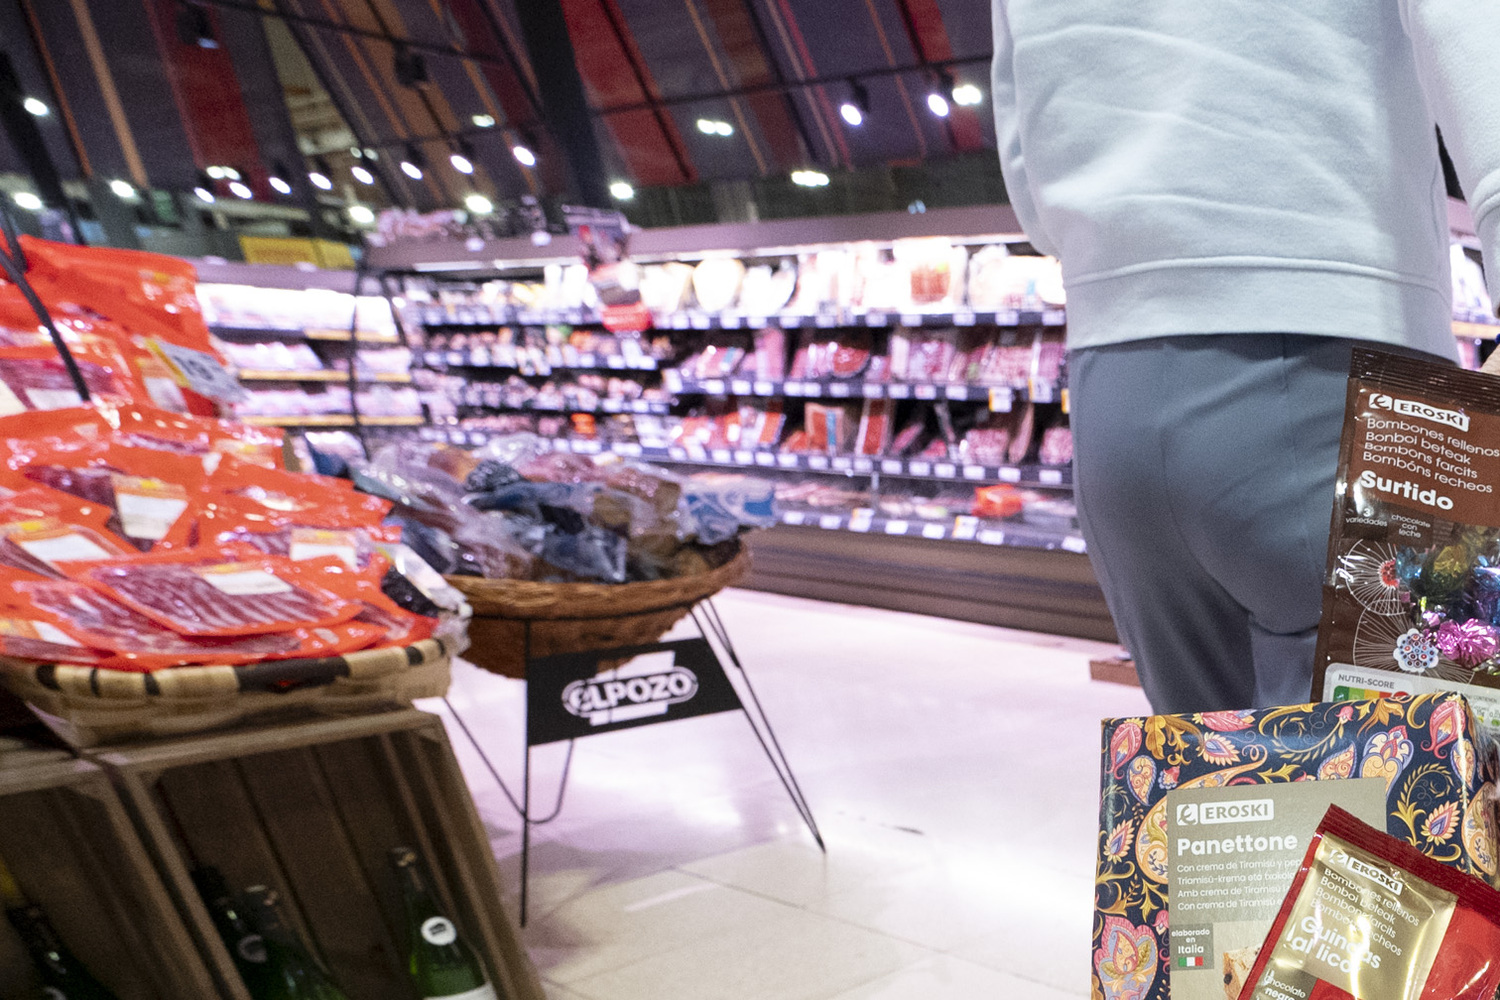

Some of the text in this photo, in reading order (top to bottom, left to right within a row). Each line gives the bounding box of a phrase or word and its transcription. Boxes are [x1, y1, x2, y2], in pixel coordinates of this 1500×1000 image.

[1400, 403, 1464, 427] EROSKI
[1367, 418, 1500, 457] Bombones rellenos
[1366, 432, 1471, 465] Bonboi beteak
[1365, 442, 1477, 479] Bombons farcits
[1363, 451, 1493, 493] Bombóns recheos
[1361, 470, 1454, 510] Surtido
[1363, 507, 1371, 517] 3
[1346, 517, 1388, 527] variedades
[1391, 514, 1431, 528] chocolate
[1402, 523, 1418, 531] con
[1399, 529, 1421, 538] leche
[1337, 673, 1396, 690] NUTRI-SCORE
[1205, 804, 1268, 820] EROSKI
[1177, 834, 1298, 856] Panettone
[1177, 864, 1195, 873] Con
[1196, 864, 1223, 872] crema
[1225, 862, 1237, 870] de
[1277, 861, 1283, 869] y
[1351, 860, 1399, 892] EROSKI
[1178, 889, 1198, 898] Amb
[1200, 888, 1229, 897] crema
[1230, 887, 1242, 895] de
[1320, 877, 1395, 924] Bonboi beteak
[1324, 868, 1420, 927] Bombones rellenos
[1178, 902, 1195, 910] Con
[1225, 900, 1238, 908] de
[1171, 928, 1210, 937] elaborado
[1178, 945, 1204, 954] Italia
[1291, 936, 1314, 954] al
[1264, 975, 1306, 998] chocolate
